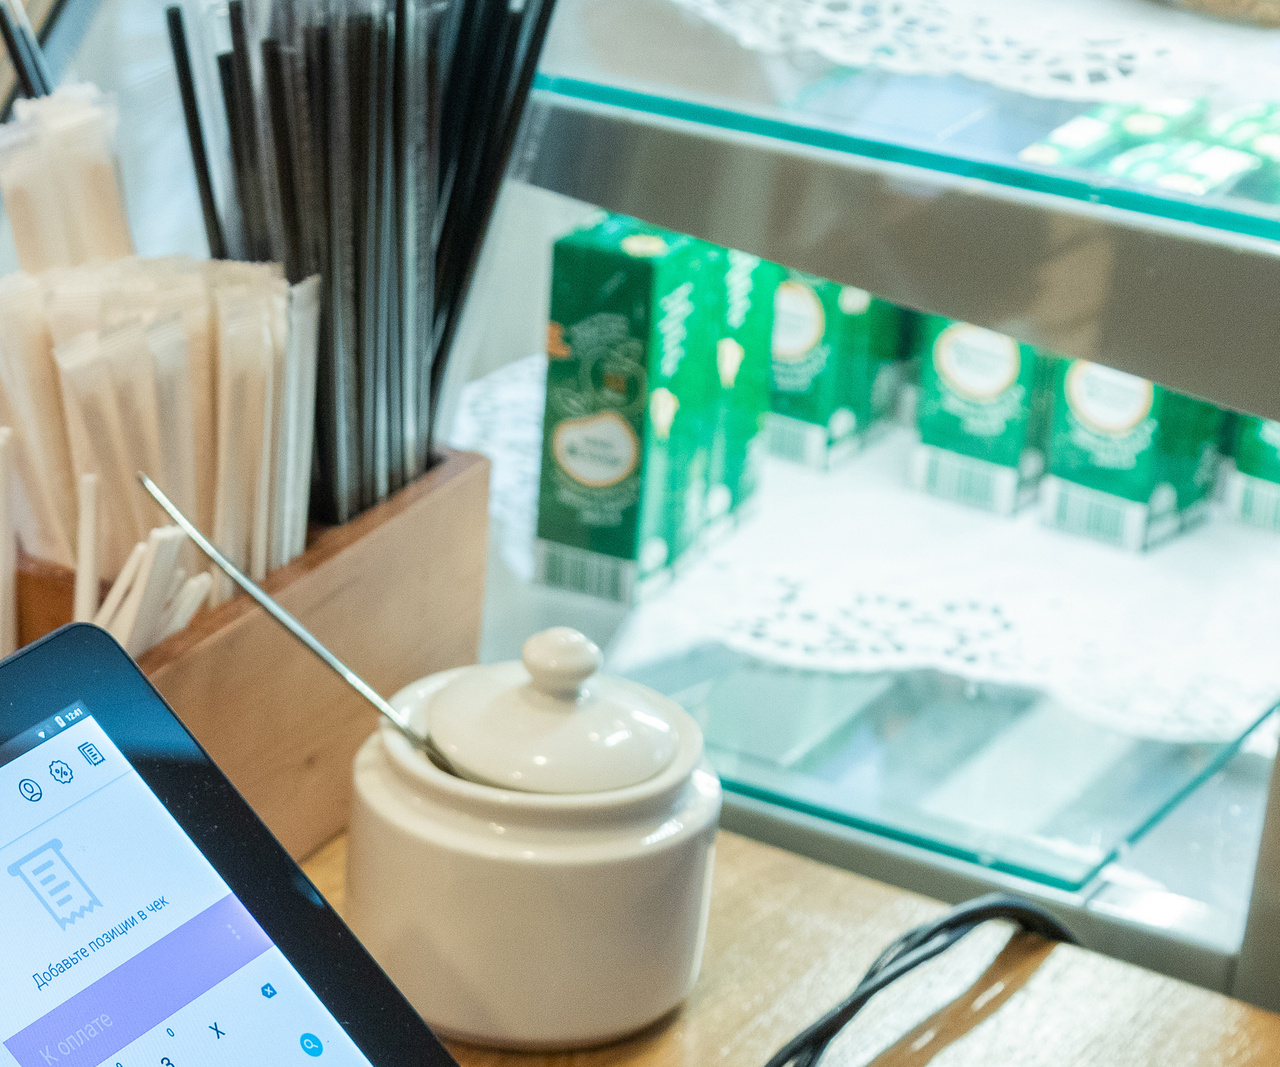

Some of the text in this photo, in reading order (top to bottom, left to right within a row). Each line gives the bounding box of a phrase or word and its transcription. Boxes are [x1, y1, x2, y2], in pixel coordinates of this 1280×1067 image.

[64, 707, 84, 722] 12:41
[32, 895, 170, 991] Добавьте позиции в чек
[38, 1012, 113, 1066] К оплате
[166, 1027, 175, 1038] 0
[208, 1021, 226, 1040] х
